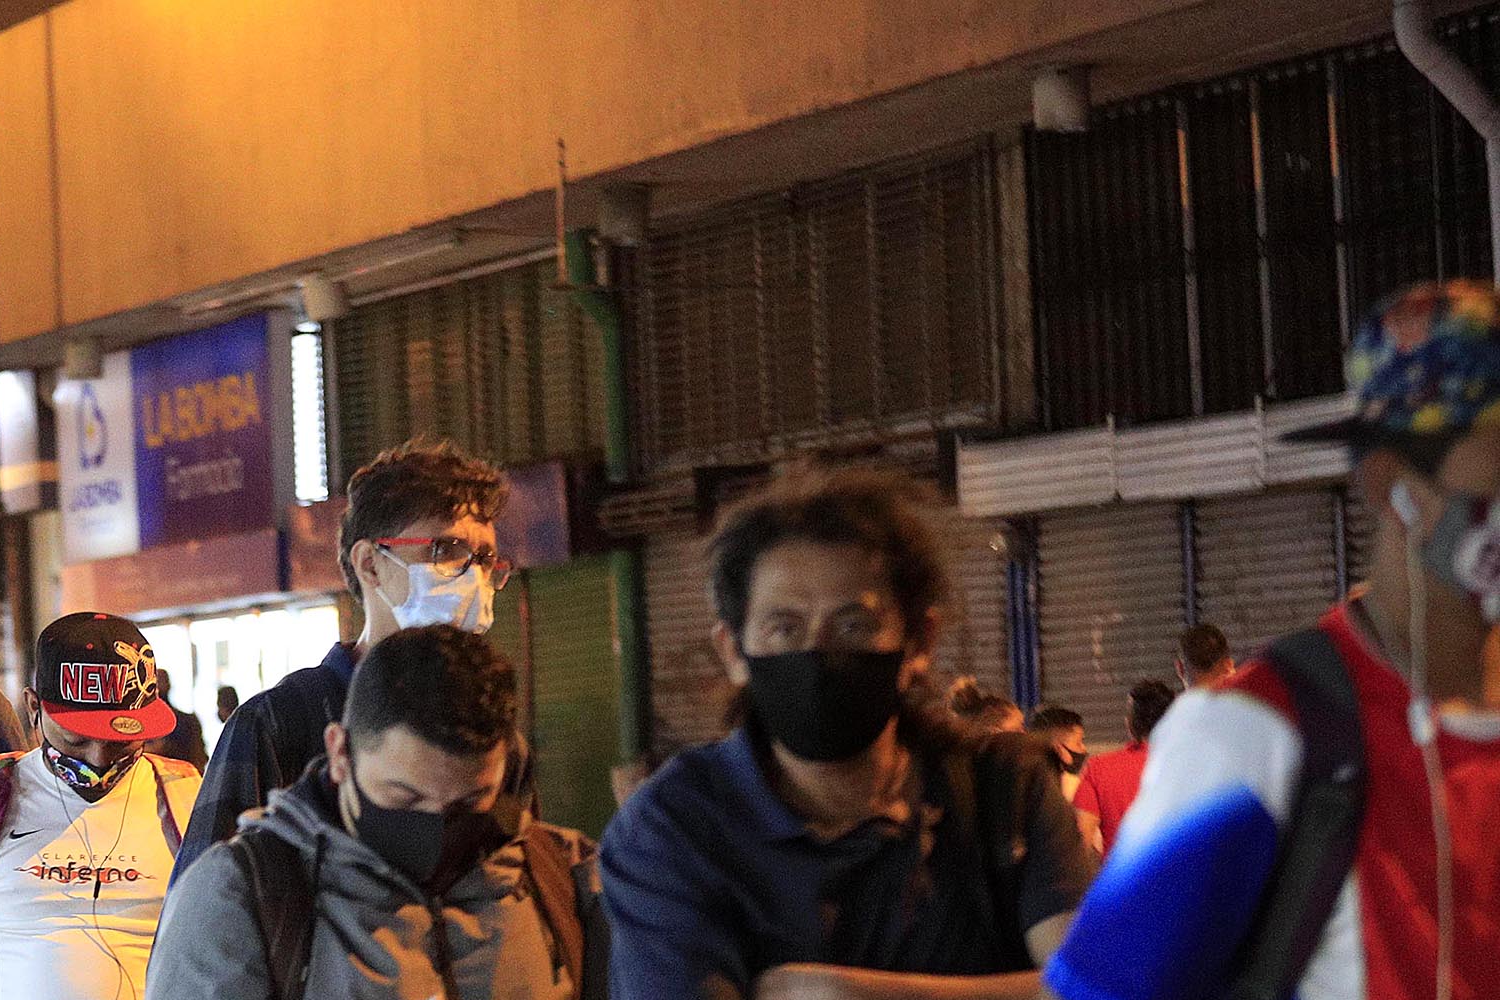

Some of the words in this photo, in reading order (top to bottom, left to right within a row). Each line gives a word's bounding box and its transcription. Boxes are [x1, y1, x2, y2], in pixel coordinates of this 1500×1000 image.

[60, 663, 129, 703] NEW
[42, 852, 138, 863] CLARENCE
[40, 862, 138, 881] inferno
